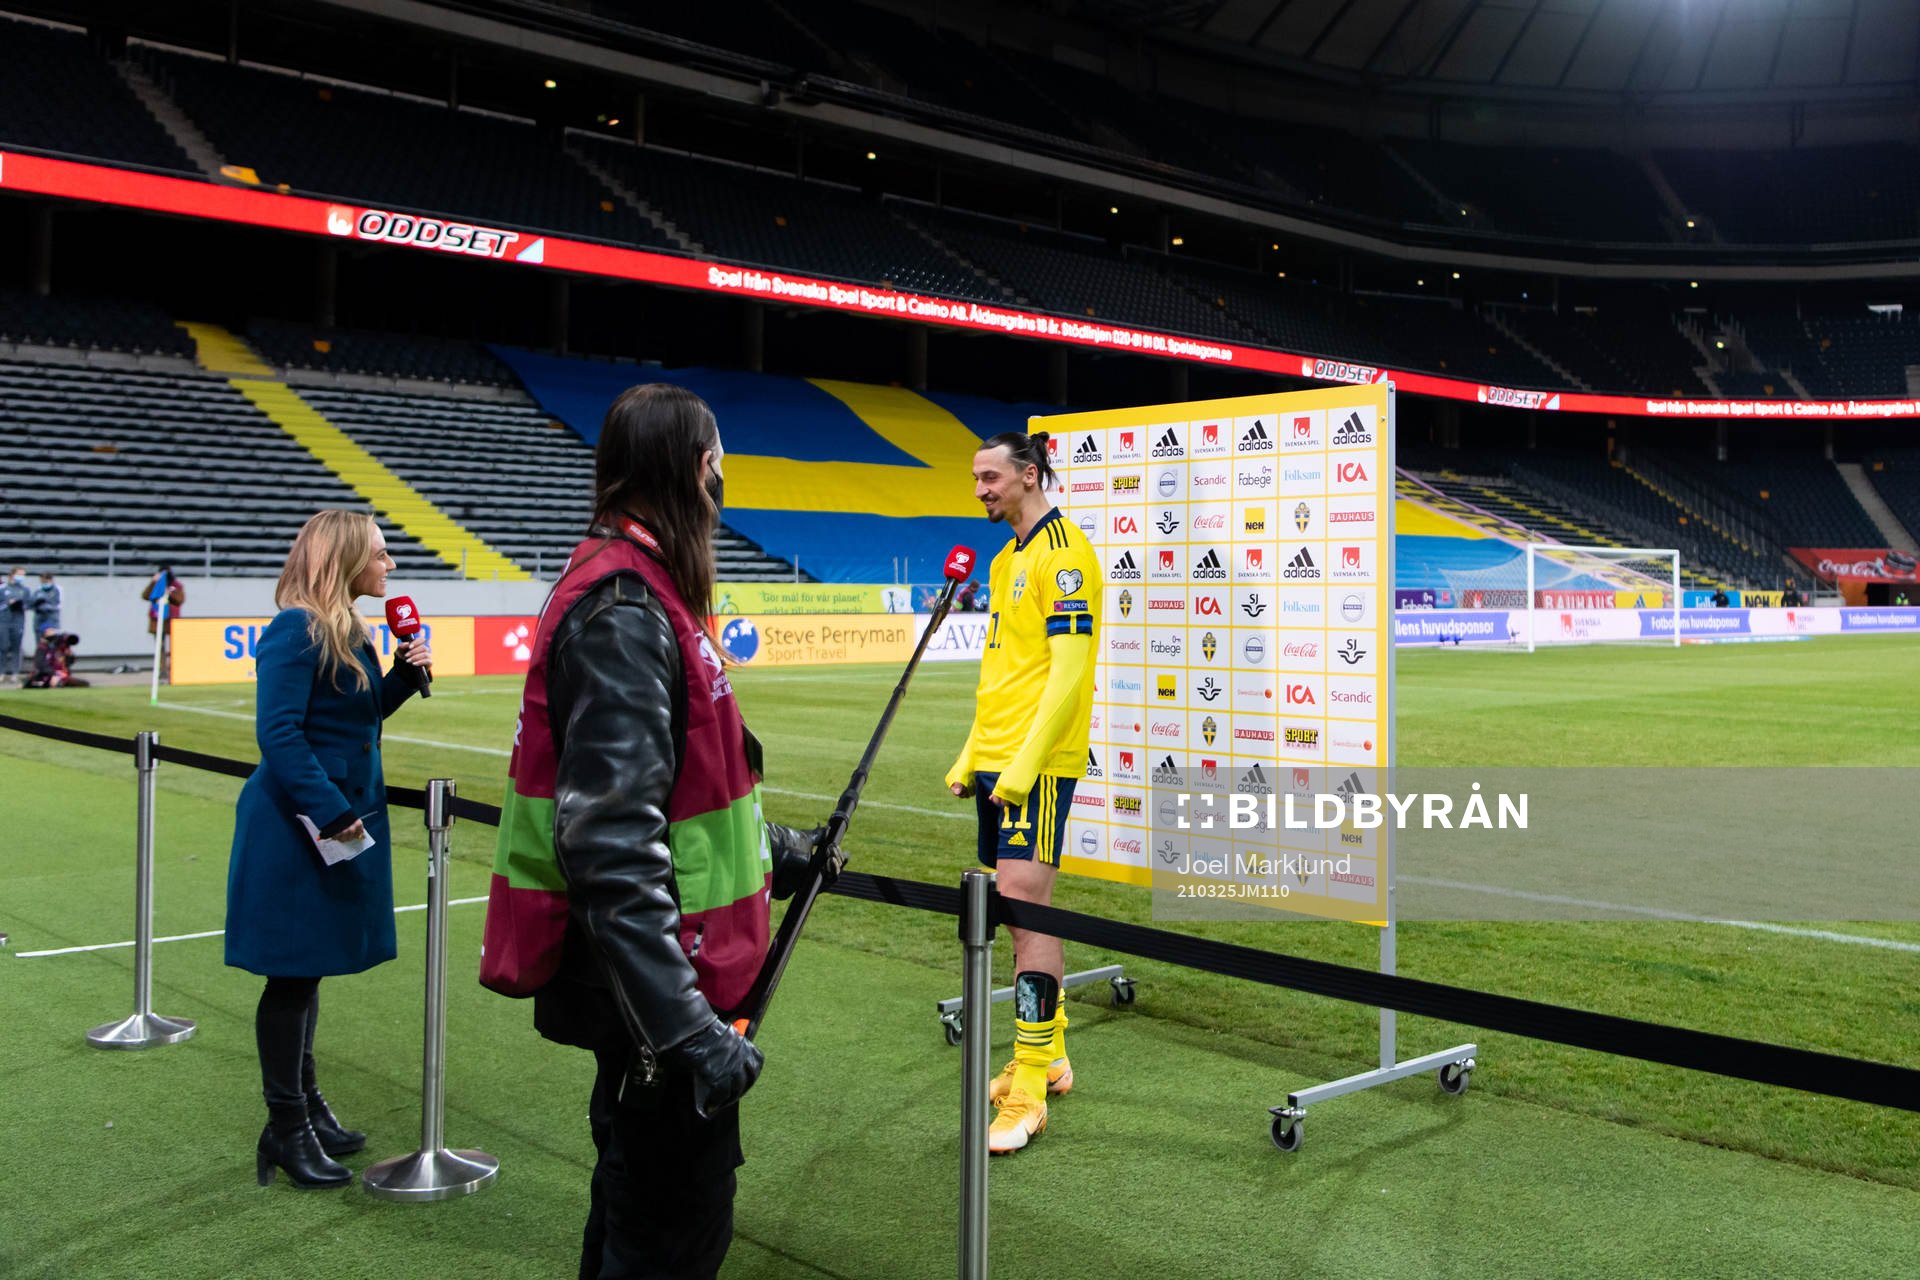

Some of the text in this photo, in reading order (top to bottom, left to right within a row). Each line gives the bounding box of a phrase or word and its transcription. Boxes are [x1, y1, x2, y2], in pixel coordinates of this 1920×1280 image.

[358, 209, 519, 258] ODDSET
[708, 267, 742, 287] Spel
[772, 277, 828, 300] Svenska
[829, 286, 859, 304] Spel
[860, 290, 895, 310] Sport
[908, 298, 949, 318] Casino
[1314, 360, 1377, 385] ODDSET
[1488, 387, 1547, 409] ODDSET
[1333, 432, 1372, 445] adidas
[1238, 439, 1273, 451] adidas
[1073, 451, 1102, 463] adidas
[1152, 446, 1184, 457] adidas
[1284, 470, 1320, 481] Folksam
[1337, 462, 1368, 483] ICA
[1112, 476, 1140, 489] SPORT
[1194, 475, 1227, 486] Scandic
[1239, 473, 1271, 488] Fabege
[1072, 482, 1104, 492] BAUHAUS
[1164, 511, 1172, 521] SJ
[1330, 511, 1374, 523] BAUHAUS
[1114, 516, 1138, 534] ICA
[1111, 569, 1141, 579] adidas
[1193, 568, 1226, 579] adidas
[1284, 566, 1320, 578] adidas
[1250, 593, 1258, 604] SJ
[1149, 601, 1184, 609] BAUHAUS
[1195, 596, 1222, 615] ICA
[1283, 601, 1320, 612] Folksam
[1421, 618, 1493, 637] huvudsponsor
[765, 627, 906, 650] Steve Perryman
[1111, 640, 1140, 650] Scandic
[1151, 640, 1181, 656] Fabege
[1347, 639, 1357, 651] SJ
[768, 647, 847, 663] Sport Travel
[1205, 677, 1214, 689] SJ
[1286, 684, 1315, 705] ICA
[1331, 691, 1372, 704] Scandic
[1235, 729, 1274, 741] BAUHAUS
[1285, 728, 1318, 744] SPORT
[1087, 766, 1102, 776] das
[1152, 774, 1183, 786] adidas
[1238, 783, 1272, 795] adidas
[1113, 796, 1141, 811] SPORT
[1165, 840, 1173, 852] SJ
